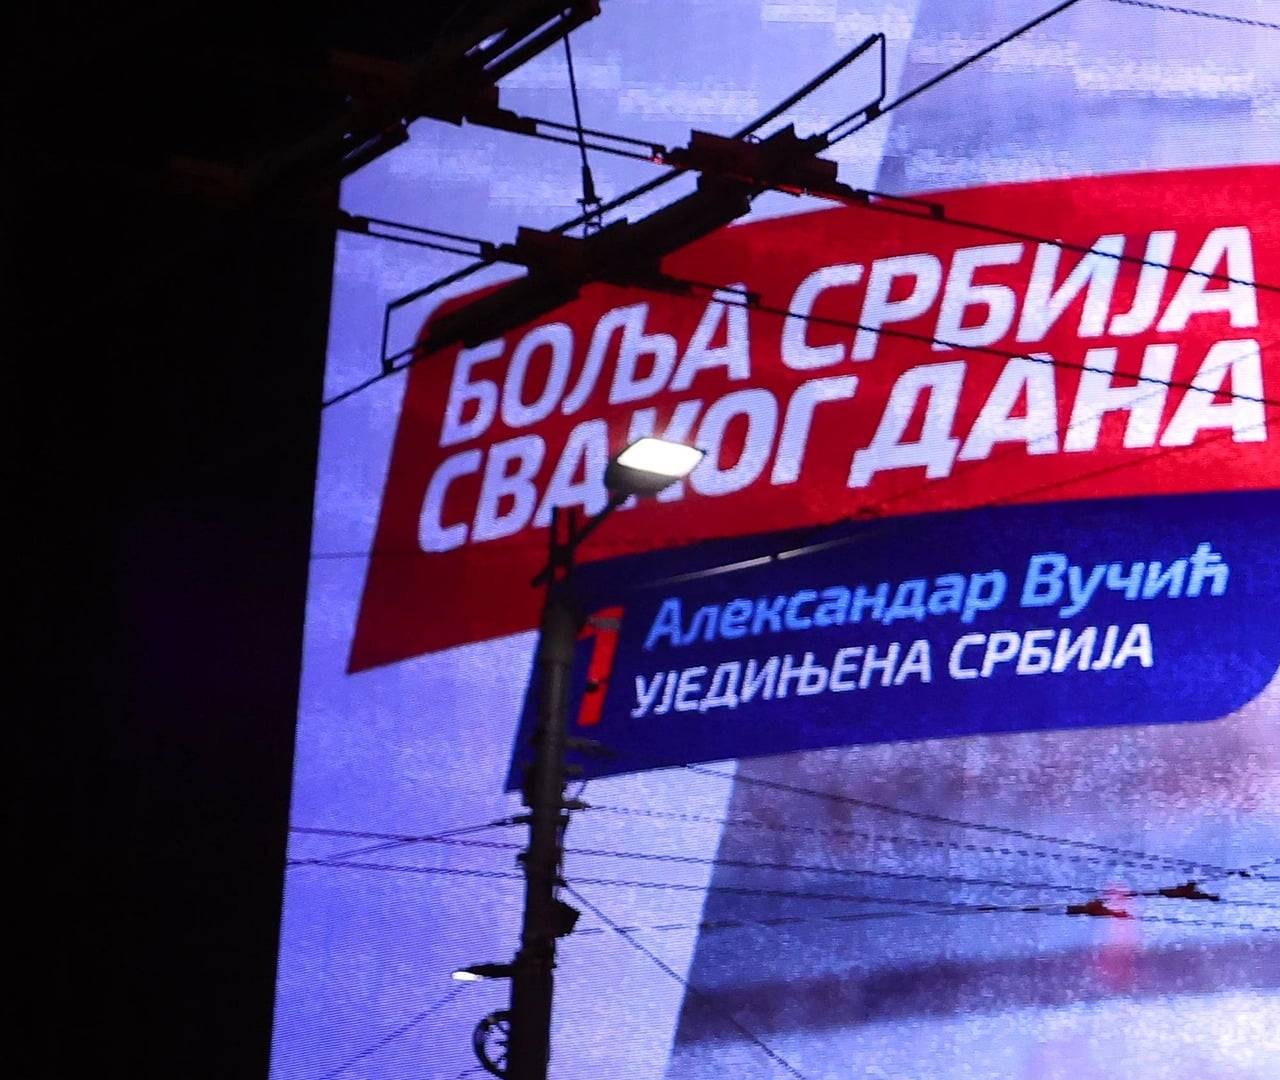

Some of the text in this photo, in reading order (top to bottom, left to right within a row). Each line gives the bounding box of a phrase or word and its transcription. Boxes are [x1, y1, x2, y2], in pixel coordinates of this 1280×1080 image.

[440, 226, 1259, 448] БОЉА СРБИЈА
[847, 338, 1268, 488] ДАНА
[642, 541, 1230, 651] Александар Вучић
[577, 605, 625, 726] 1
[631, 622, 1153, 718] УЈЕДИЊЕНА СРБИЈА
